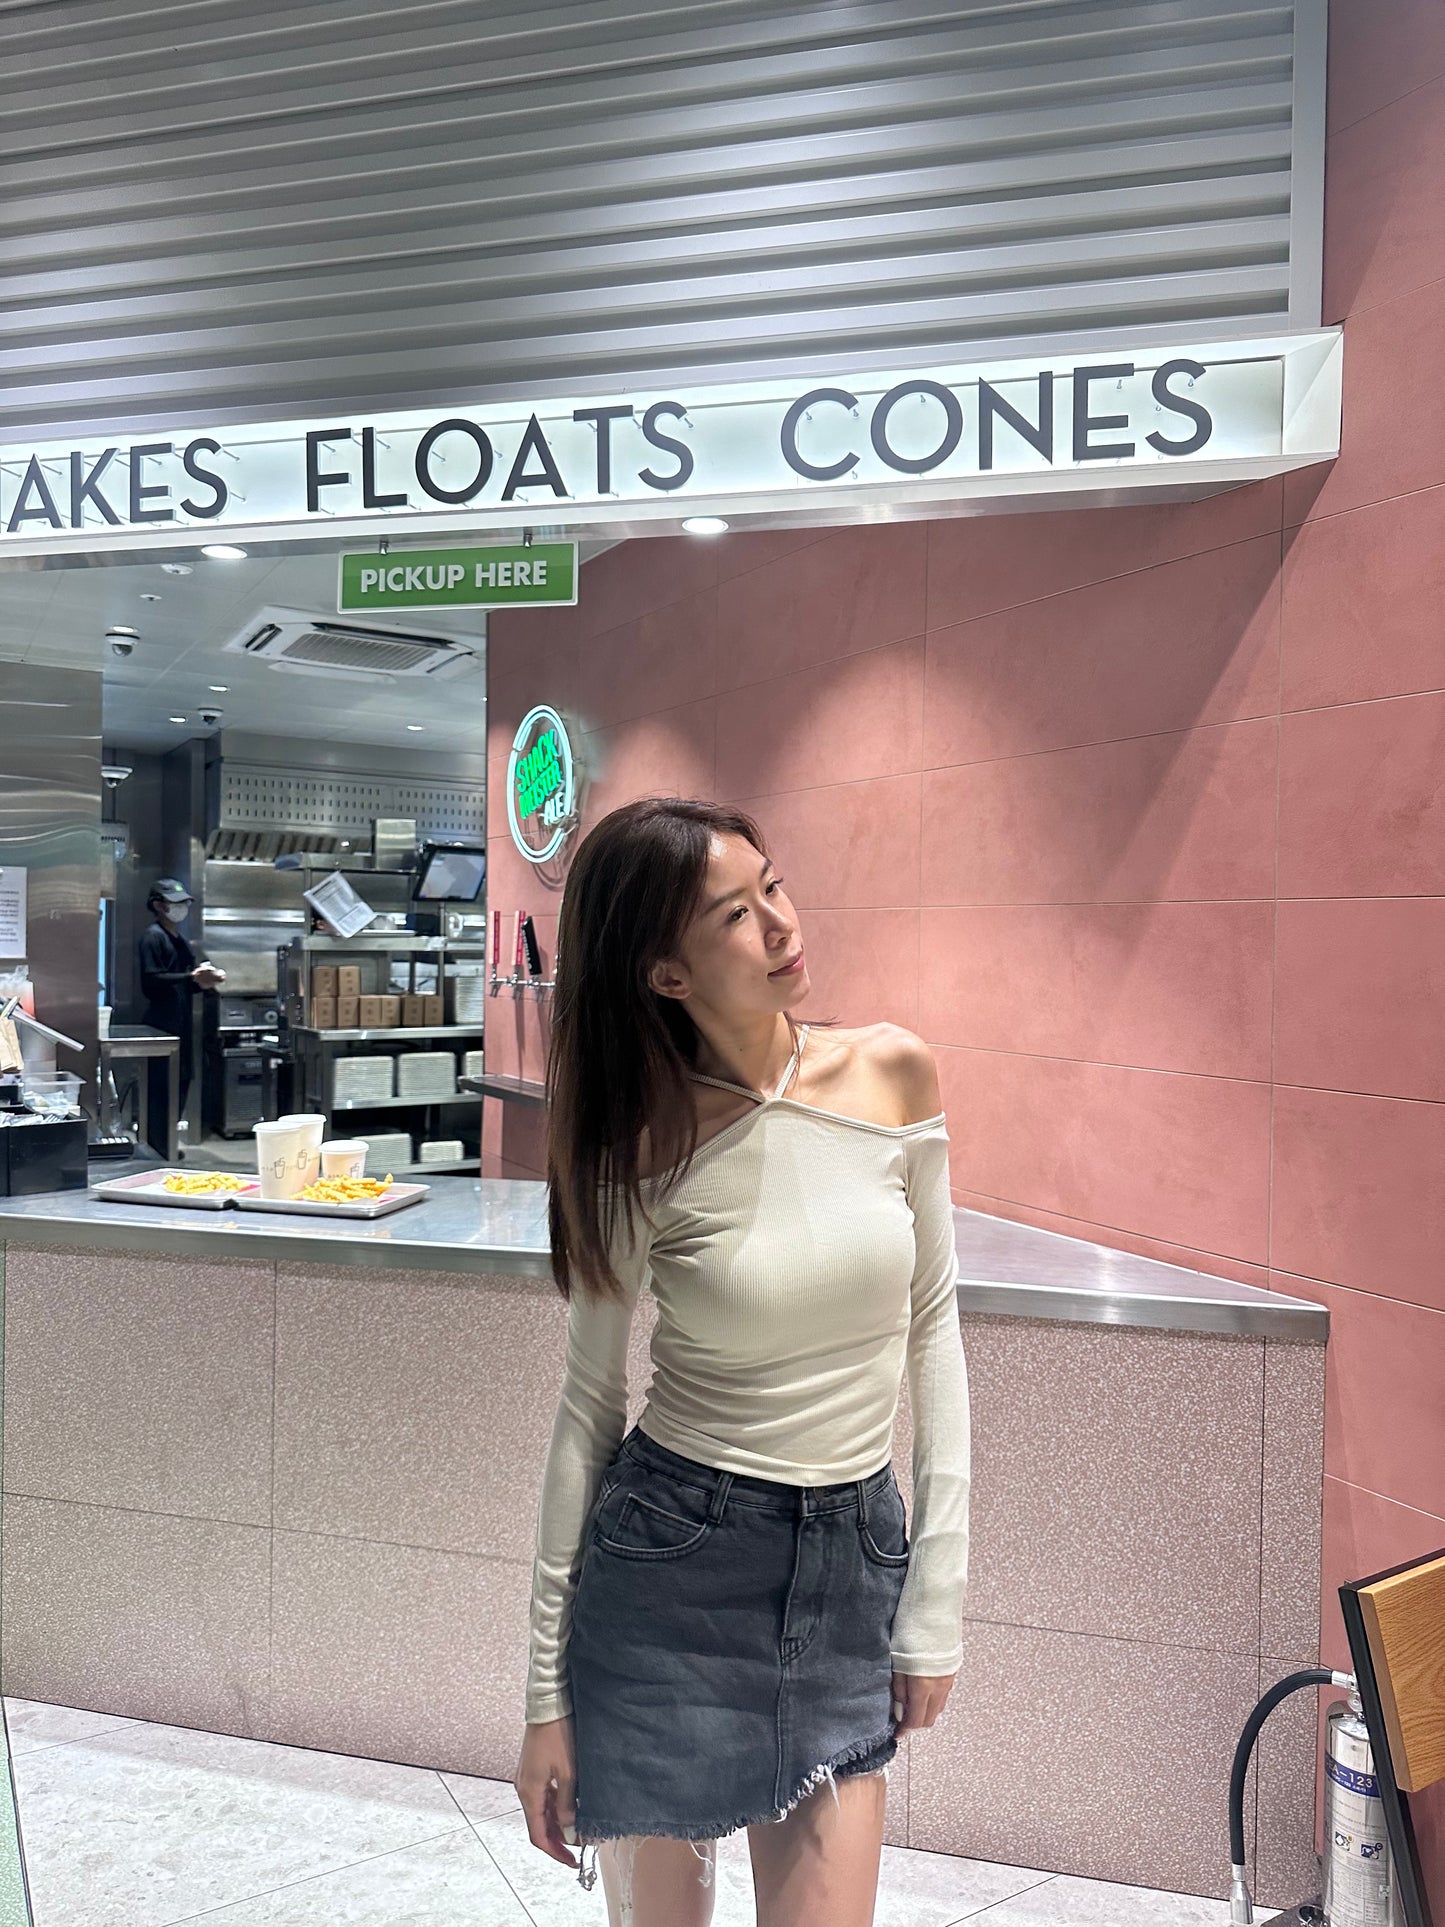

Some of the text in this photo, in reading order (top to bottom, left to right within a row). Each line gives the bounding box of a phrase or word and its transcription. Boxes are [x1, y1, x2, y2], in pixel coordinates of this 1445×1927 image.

[0, 359, 1212, 534] AKES FLOATS CONES
[361, 560, 548, 593] PICKUP HERE
[516, 729, 559, 792] SHACK
[519, 760, 562, 820] MEISTER
[544, 791, 567, 826] ALE
